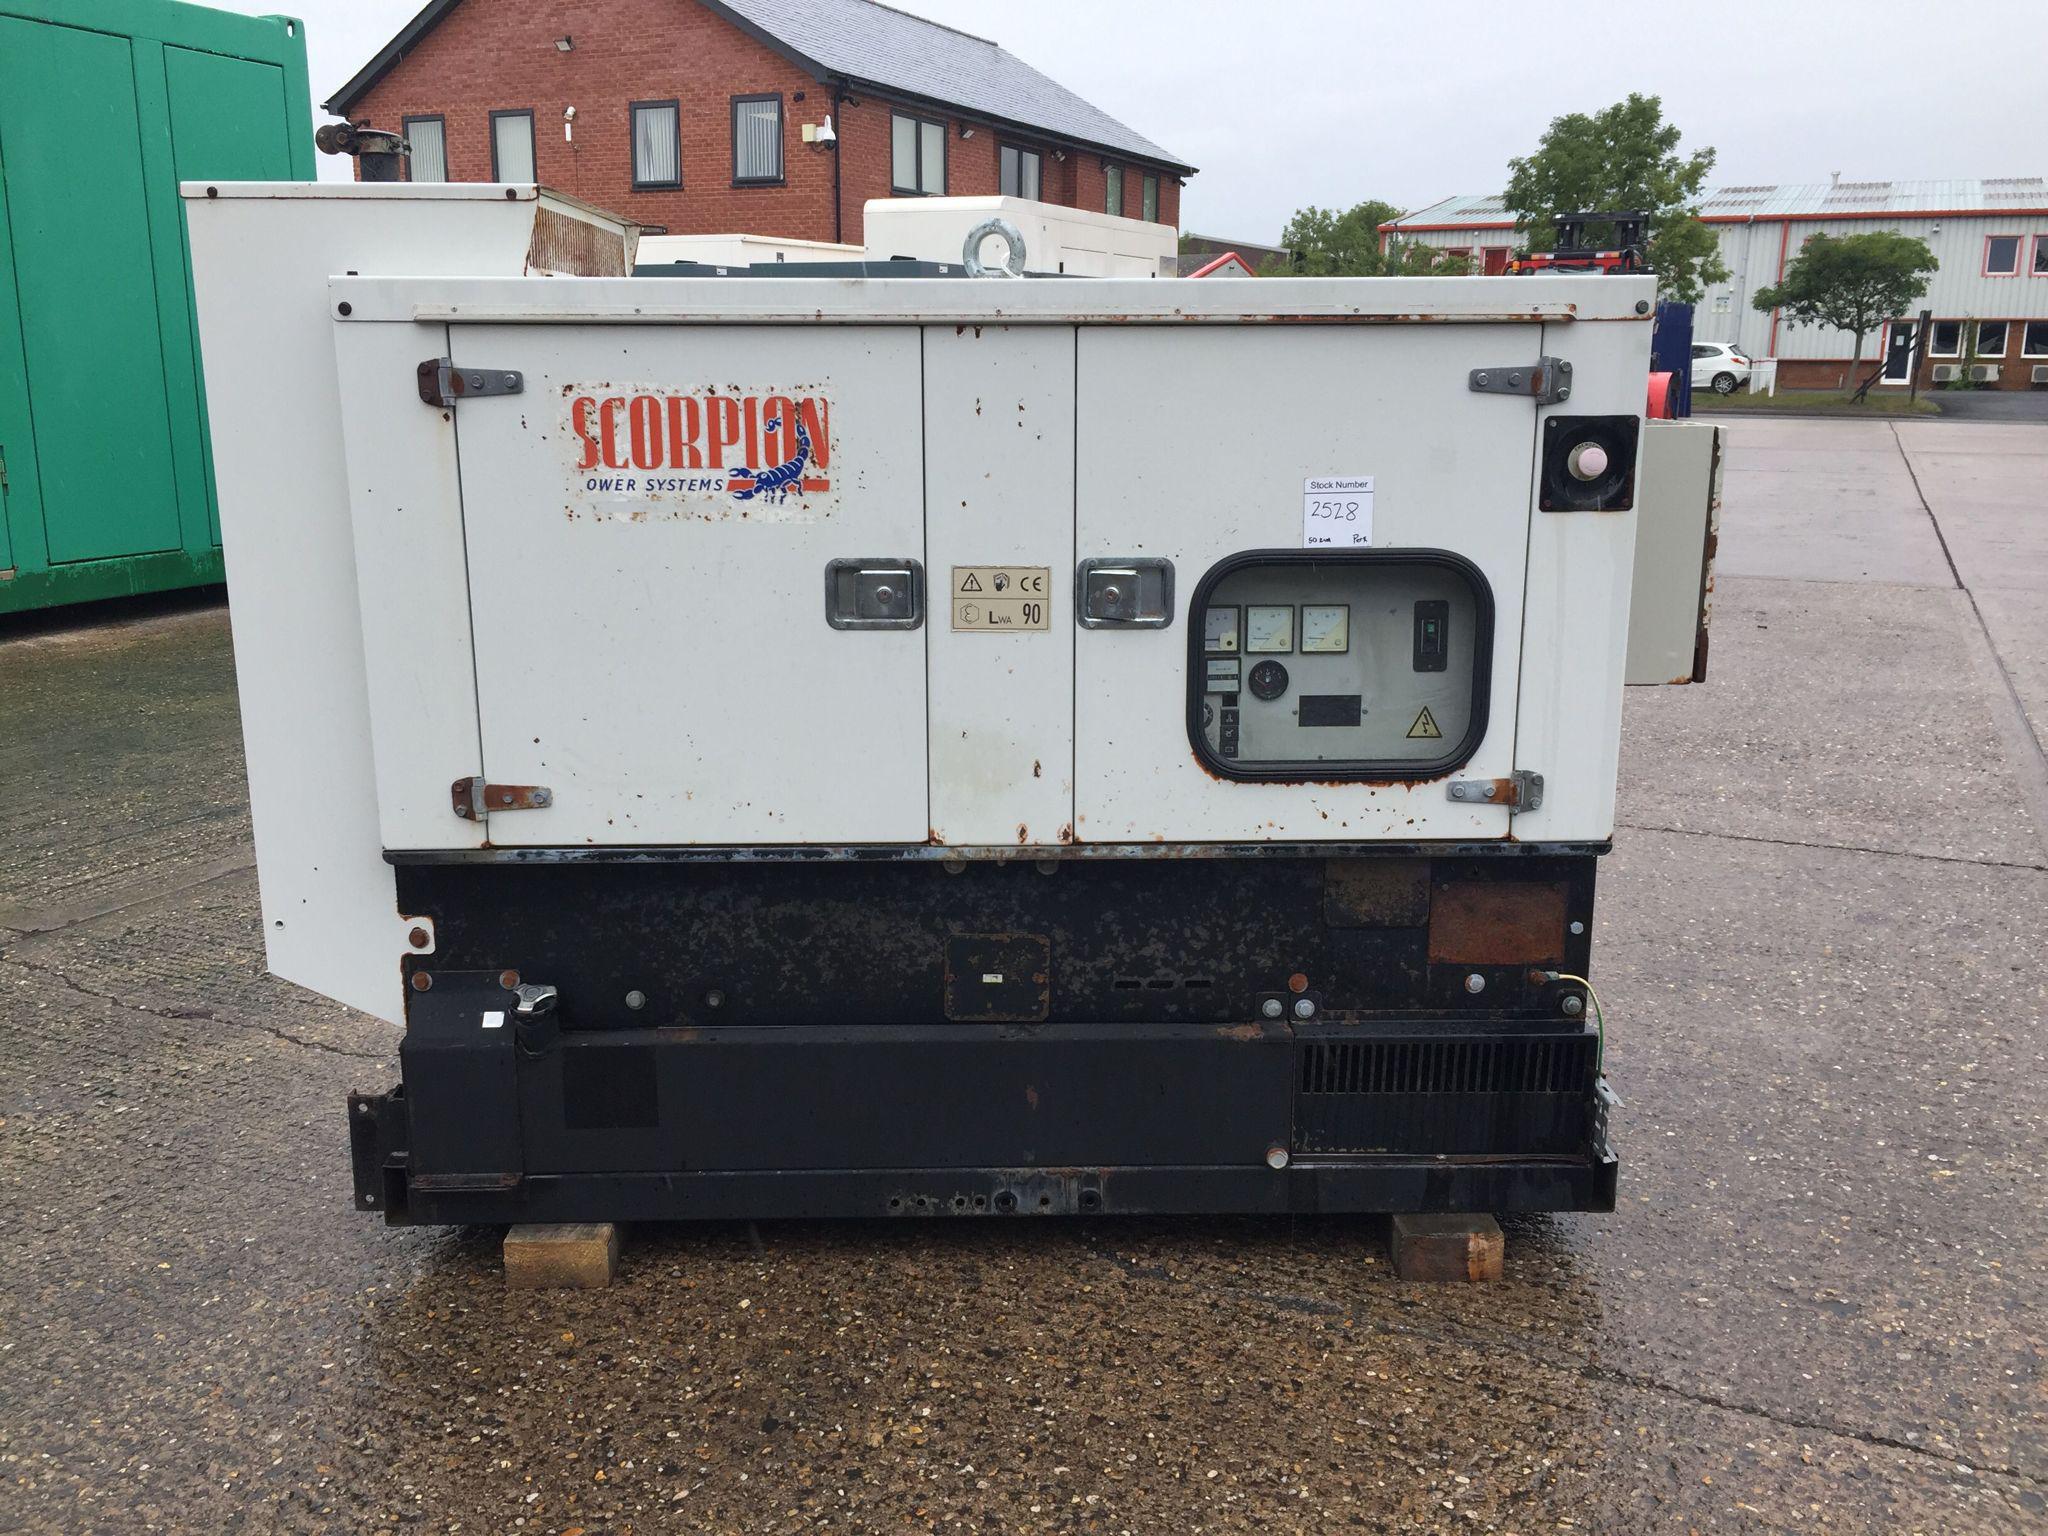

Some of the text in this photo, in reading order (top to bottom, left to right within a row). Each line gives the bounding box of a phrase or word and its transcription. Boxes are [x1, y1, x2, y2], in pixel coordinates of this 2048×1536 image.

[572, 395, 830, 470] SCORPION
[586, 478, 724, 492] OWER SYSTEMS
[1310, 481, 1369, 490] Stock Number
[1311, 501, 1359, 521] 2528
[1020, 576, 1042, 592] CE
[1023, 603, 1041, 624] 90
